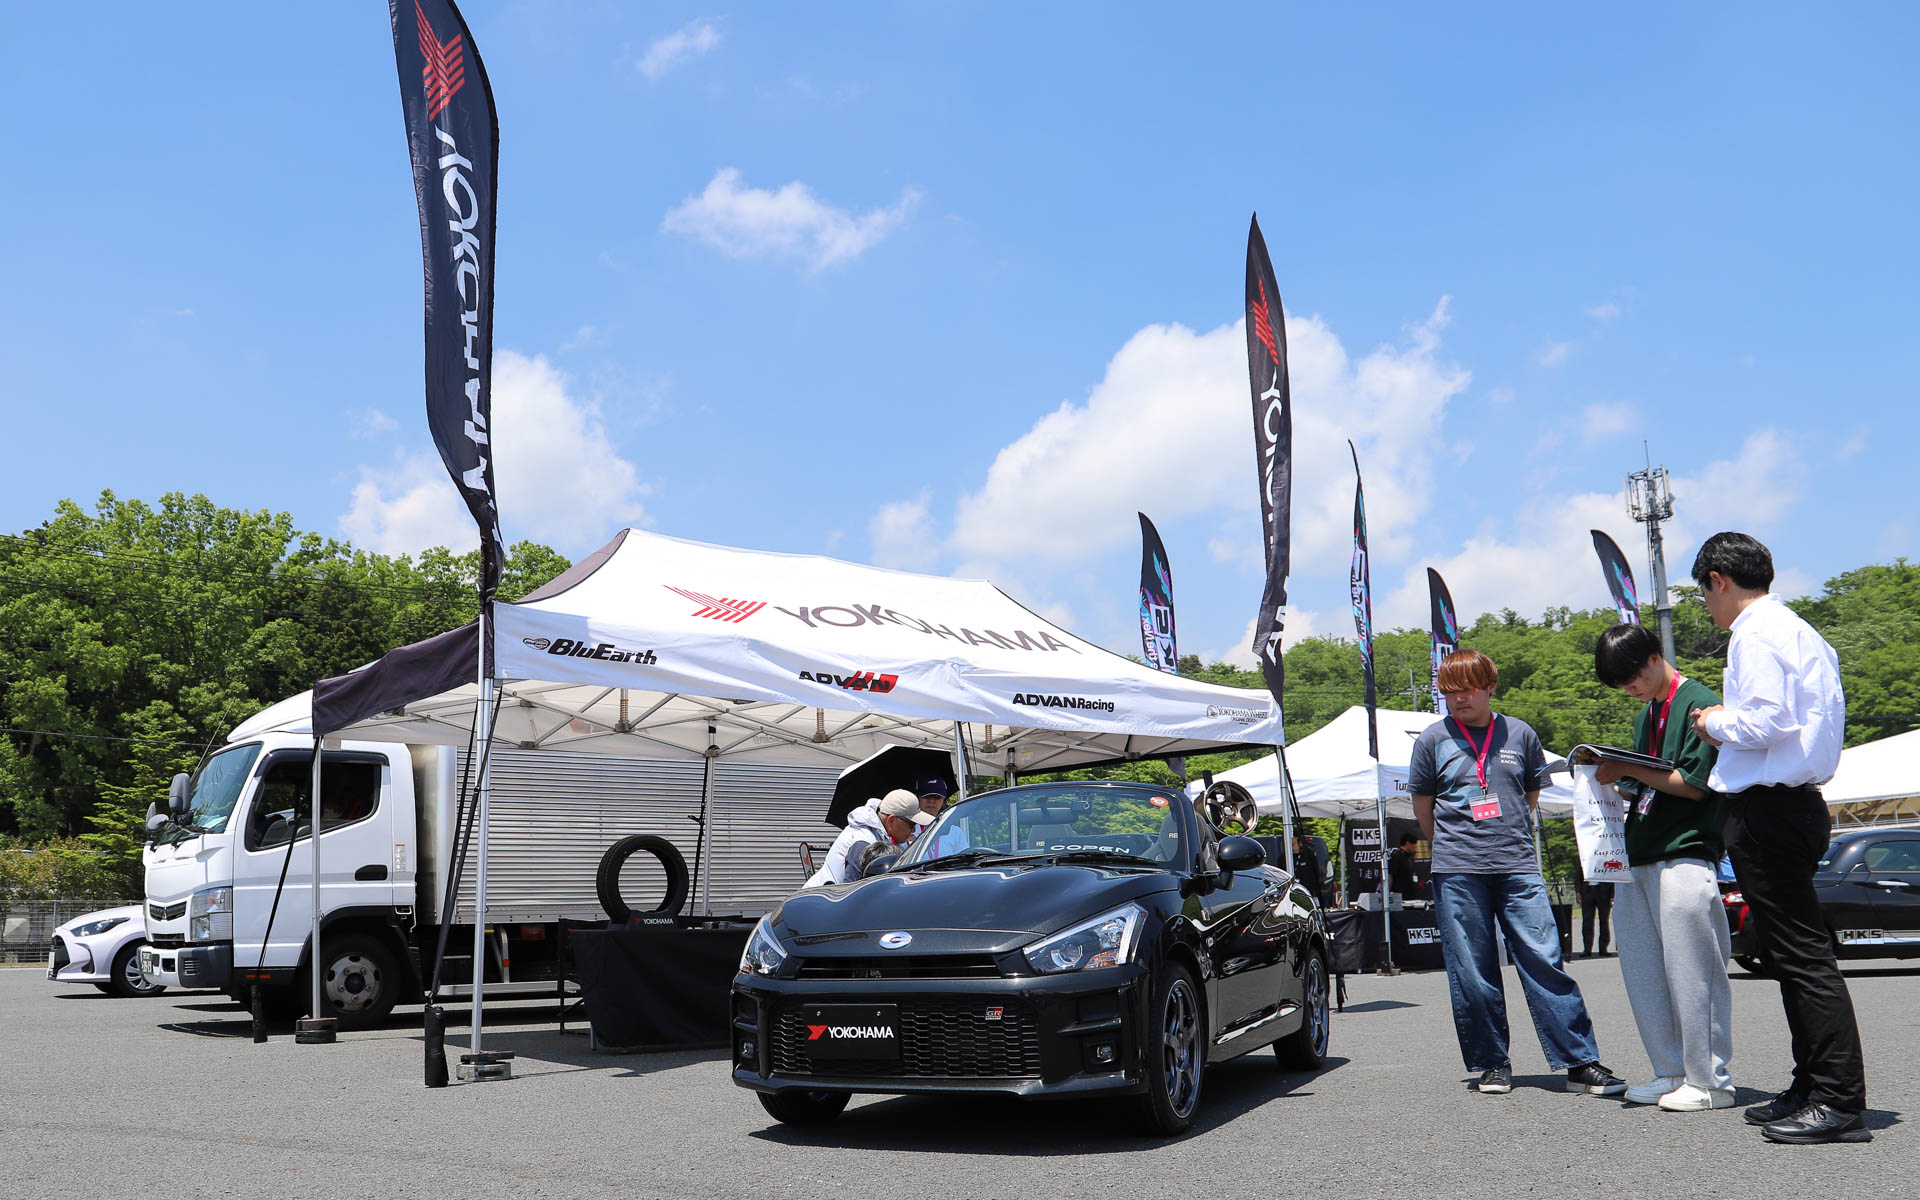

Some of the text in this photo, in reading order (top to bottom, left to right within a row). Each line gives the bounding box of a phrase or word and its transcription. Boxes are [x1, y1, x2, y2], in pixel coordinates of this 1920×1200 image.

[773, 603, 1082, 654] YOKOHAMA
[548, 638, 657, 665] BluEarth
[799, 670, 891, 691] ADVAN
[1050, 845, 1130, 854] COPEN
[1408, 928, 1432, 940] HKS
[1843, 930, 1882, 939] HKS
[828, 1026, 894, 1039] YOKOHAMA
